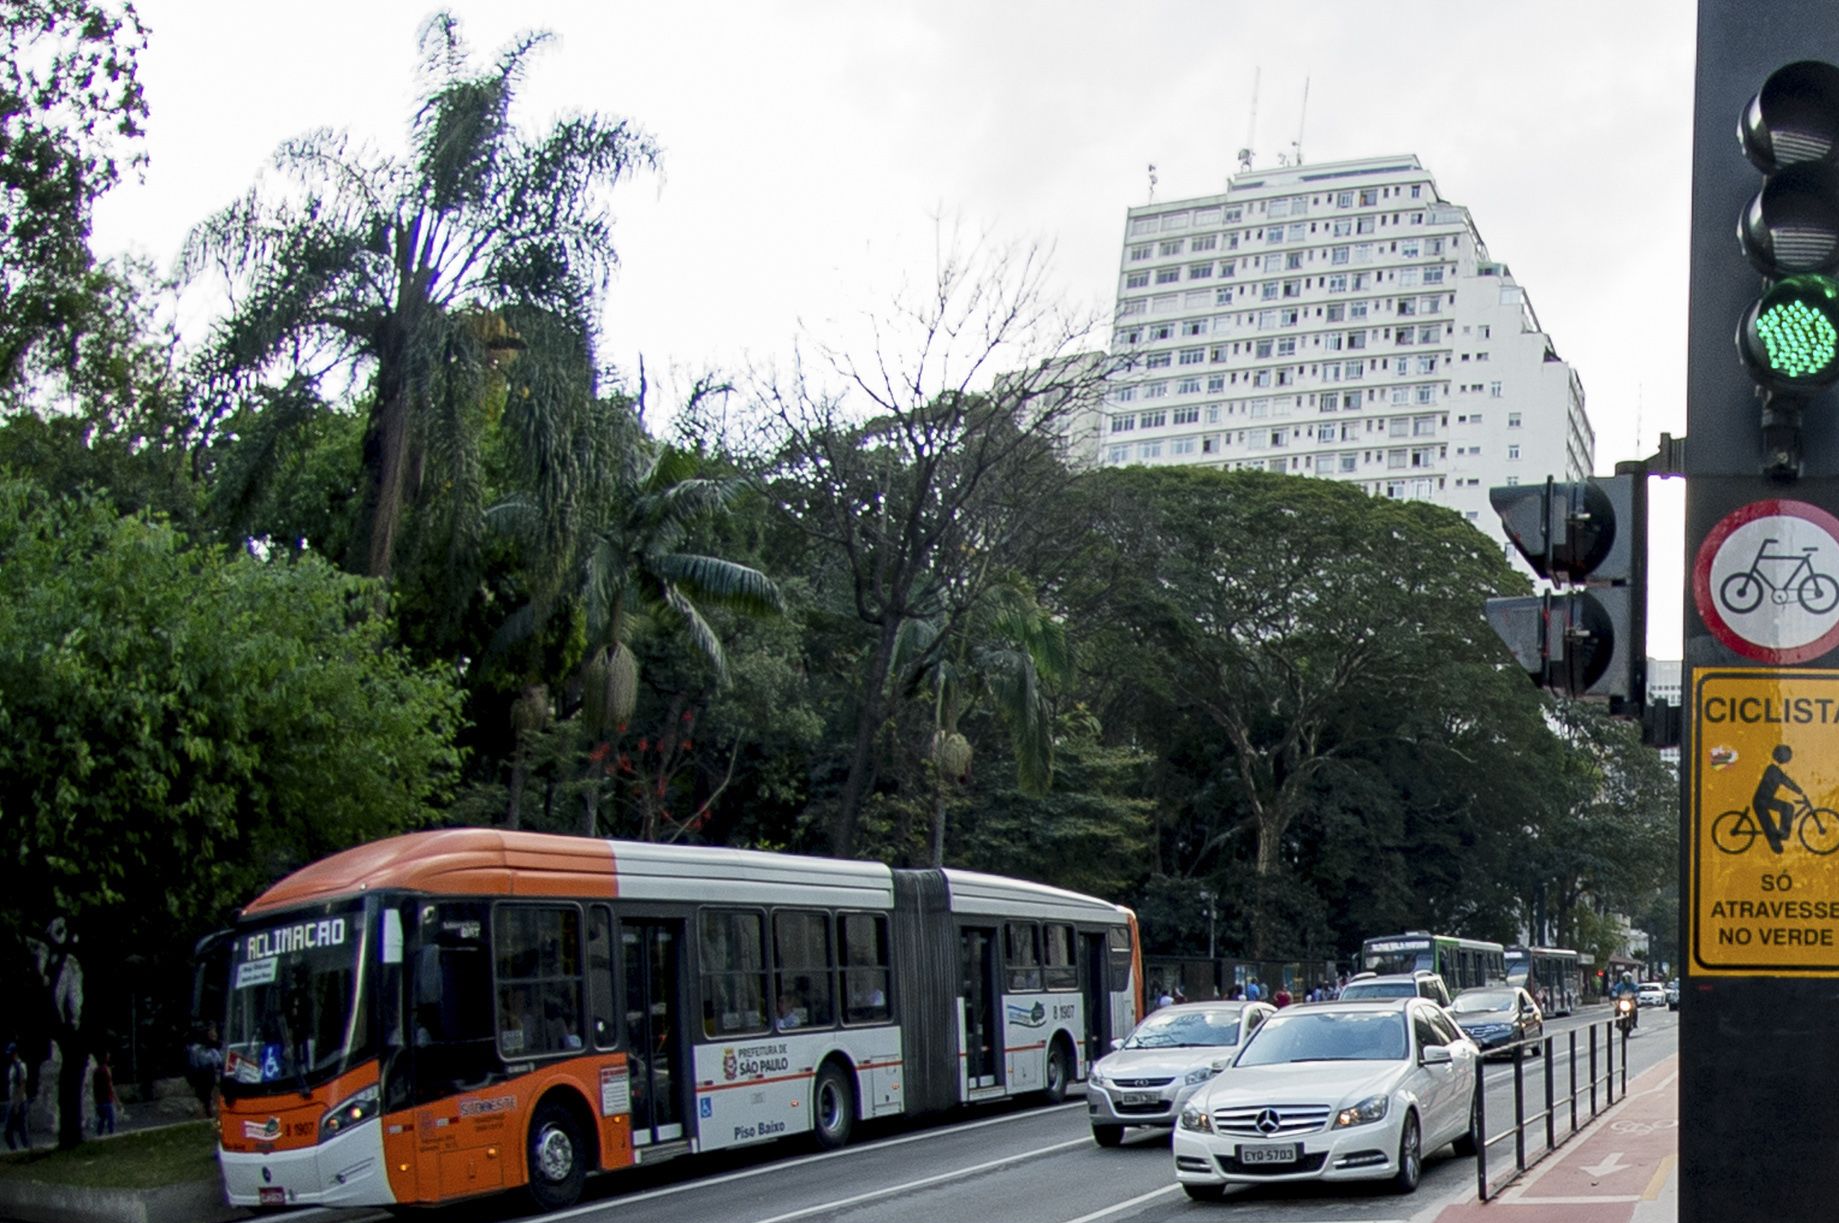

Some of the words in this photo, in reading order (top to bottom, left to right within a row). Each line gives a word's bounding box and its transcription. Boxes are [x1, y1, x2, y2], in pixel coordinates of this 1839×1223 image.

[1760, 869, 1793, 892] SÓ
[1719, 928, 1751, 946] NO
[1758, 927, 1834, 946] VERDE
[739, 1058, 759, 1076] SÃO
[760, 1057, 789, 1073] PAULO
[734, 1125, 756, 1140] Piso
[757, 1120, 786, 1136] Baixo
